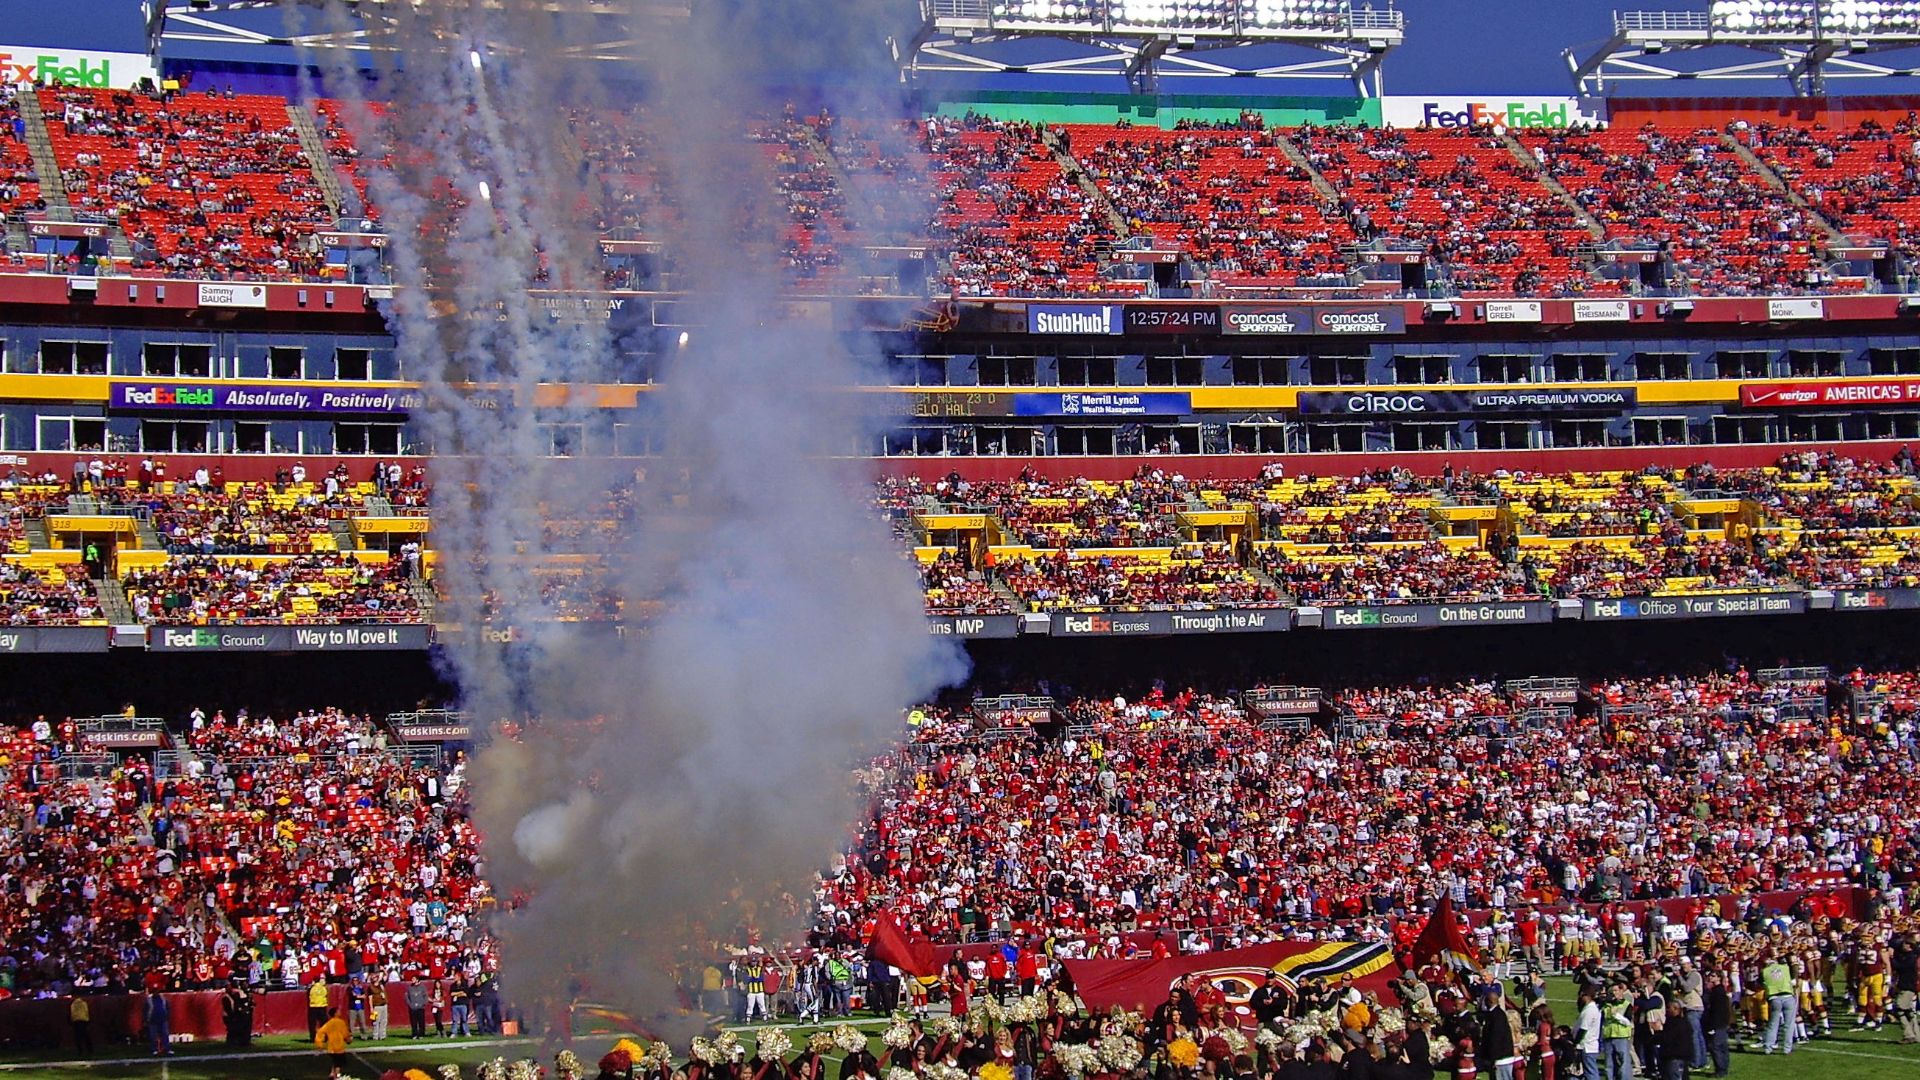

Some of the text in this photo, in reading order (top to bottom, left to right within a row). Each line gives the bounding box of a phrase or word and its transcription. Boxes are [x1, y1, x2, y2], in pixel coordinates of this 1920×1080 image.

[1424, 103, 1568, 127] FedExField
[32, 225, 49, 234] 424
[83, 227, 101, 236] 425
[323, 236, 339, 245] 425
[909, 251, 924, 259] 428
[1162, 254, 1176, 262] 429
[1405, 255, 1420, 263] 430
[201, 287, 234, 296] Sammy
[201, 295, 233, 303] BAUGH
[1489, 304, 1513, 312] Darrell
[1578, 311, 1621, 319] THEISMANN
[1772, 309, 1794, 317] MONK
[1037, 306, 1111, 333] StubHub!
[1130, 312, 1216, 326] 12:57:24 PM
[1229, 312, 1287, 325] comcast
[1322, 312, 1380, 324] comcast
[1239, 323, 1295, 332] SPORTSNET
[1332, 323, 1387, 332] SPORTSNET
[1779, 391, 1818, 402] verizon
[1825, 385, 1901, 400] AMERICA'S
[125, 387, 213, 405] FedExField
[226, 391, 311, 408] Absolutely,
[321, 393, 396, 411] Positively
[1082, 395, 1139, 407] Merrill Lynch
[1477, 396, 1516, 406] ULTRA
[1519, 394, 1579, 405] PREMIUM
[1581, 393, 1625, 403] VODKA
[1105, 406, 1145, 414] Management
[53, 520, 71, 529] 318
[108, 520, 126, 529] 319
[408, 521, 425, 530] 320
[968, 519, 983, 527] 322
[1844, 592, 1887, 607] FedEx
[1594, 596, 1791, 617] FedEx Office Your Special Team
[1335, 606, 1526, 625] FedEx Ground On the Ground
[956, 619, 984, 634] MVP
[1065, 614, 1265, 633] FedEx Express Through the Air
[164, 628, 398, 648] FedEx Ground Way to Move It
[399, 727, 469, 736] redskins.com
